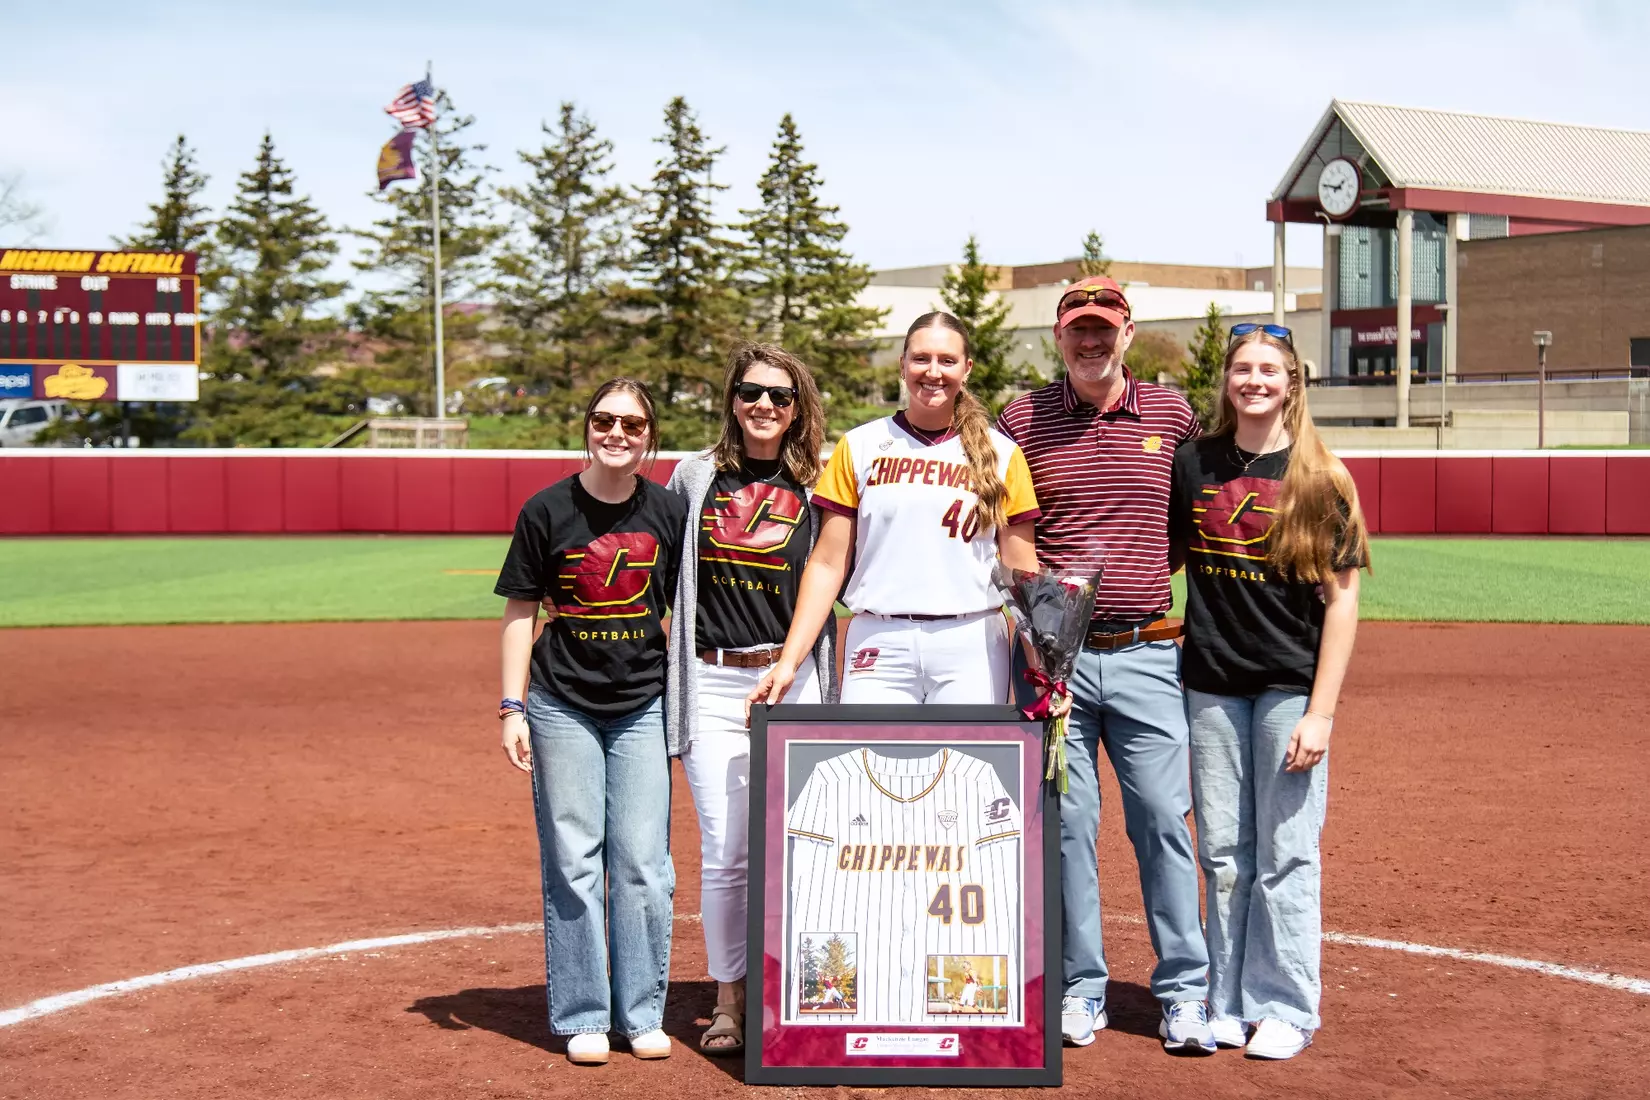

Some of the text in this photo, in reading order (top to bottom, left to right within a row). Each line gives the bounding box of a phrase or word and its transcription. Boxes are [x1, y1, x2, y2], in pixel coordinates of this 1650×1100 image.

[96, 252, 185, 273] SOFTBALL
[866, 457, 979, 495] CHIPPEWA
[941, 499, 980, 543] 40
[712, 575, 780, 594] SOFTBALL
[839, 843, 966, 872] CHIPPEWAS
[927, 883, 985, 925] 40
